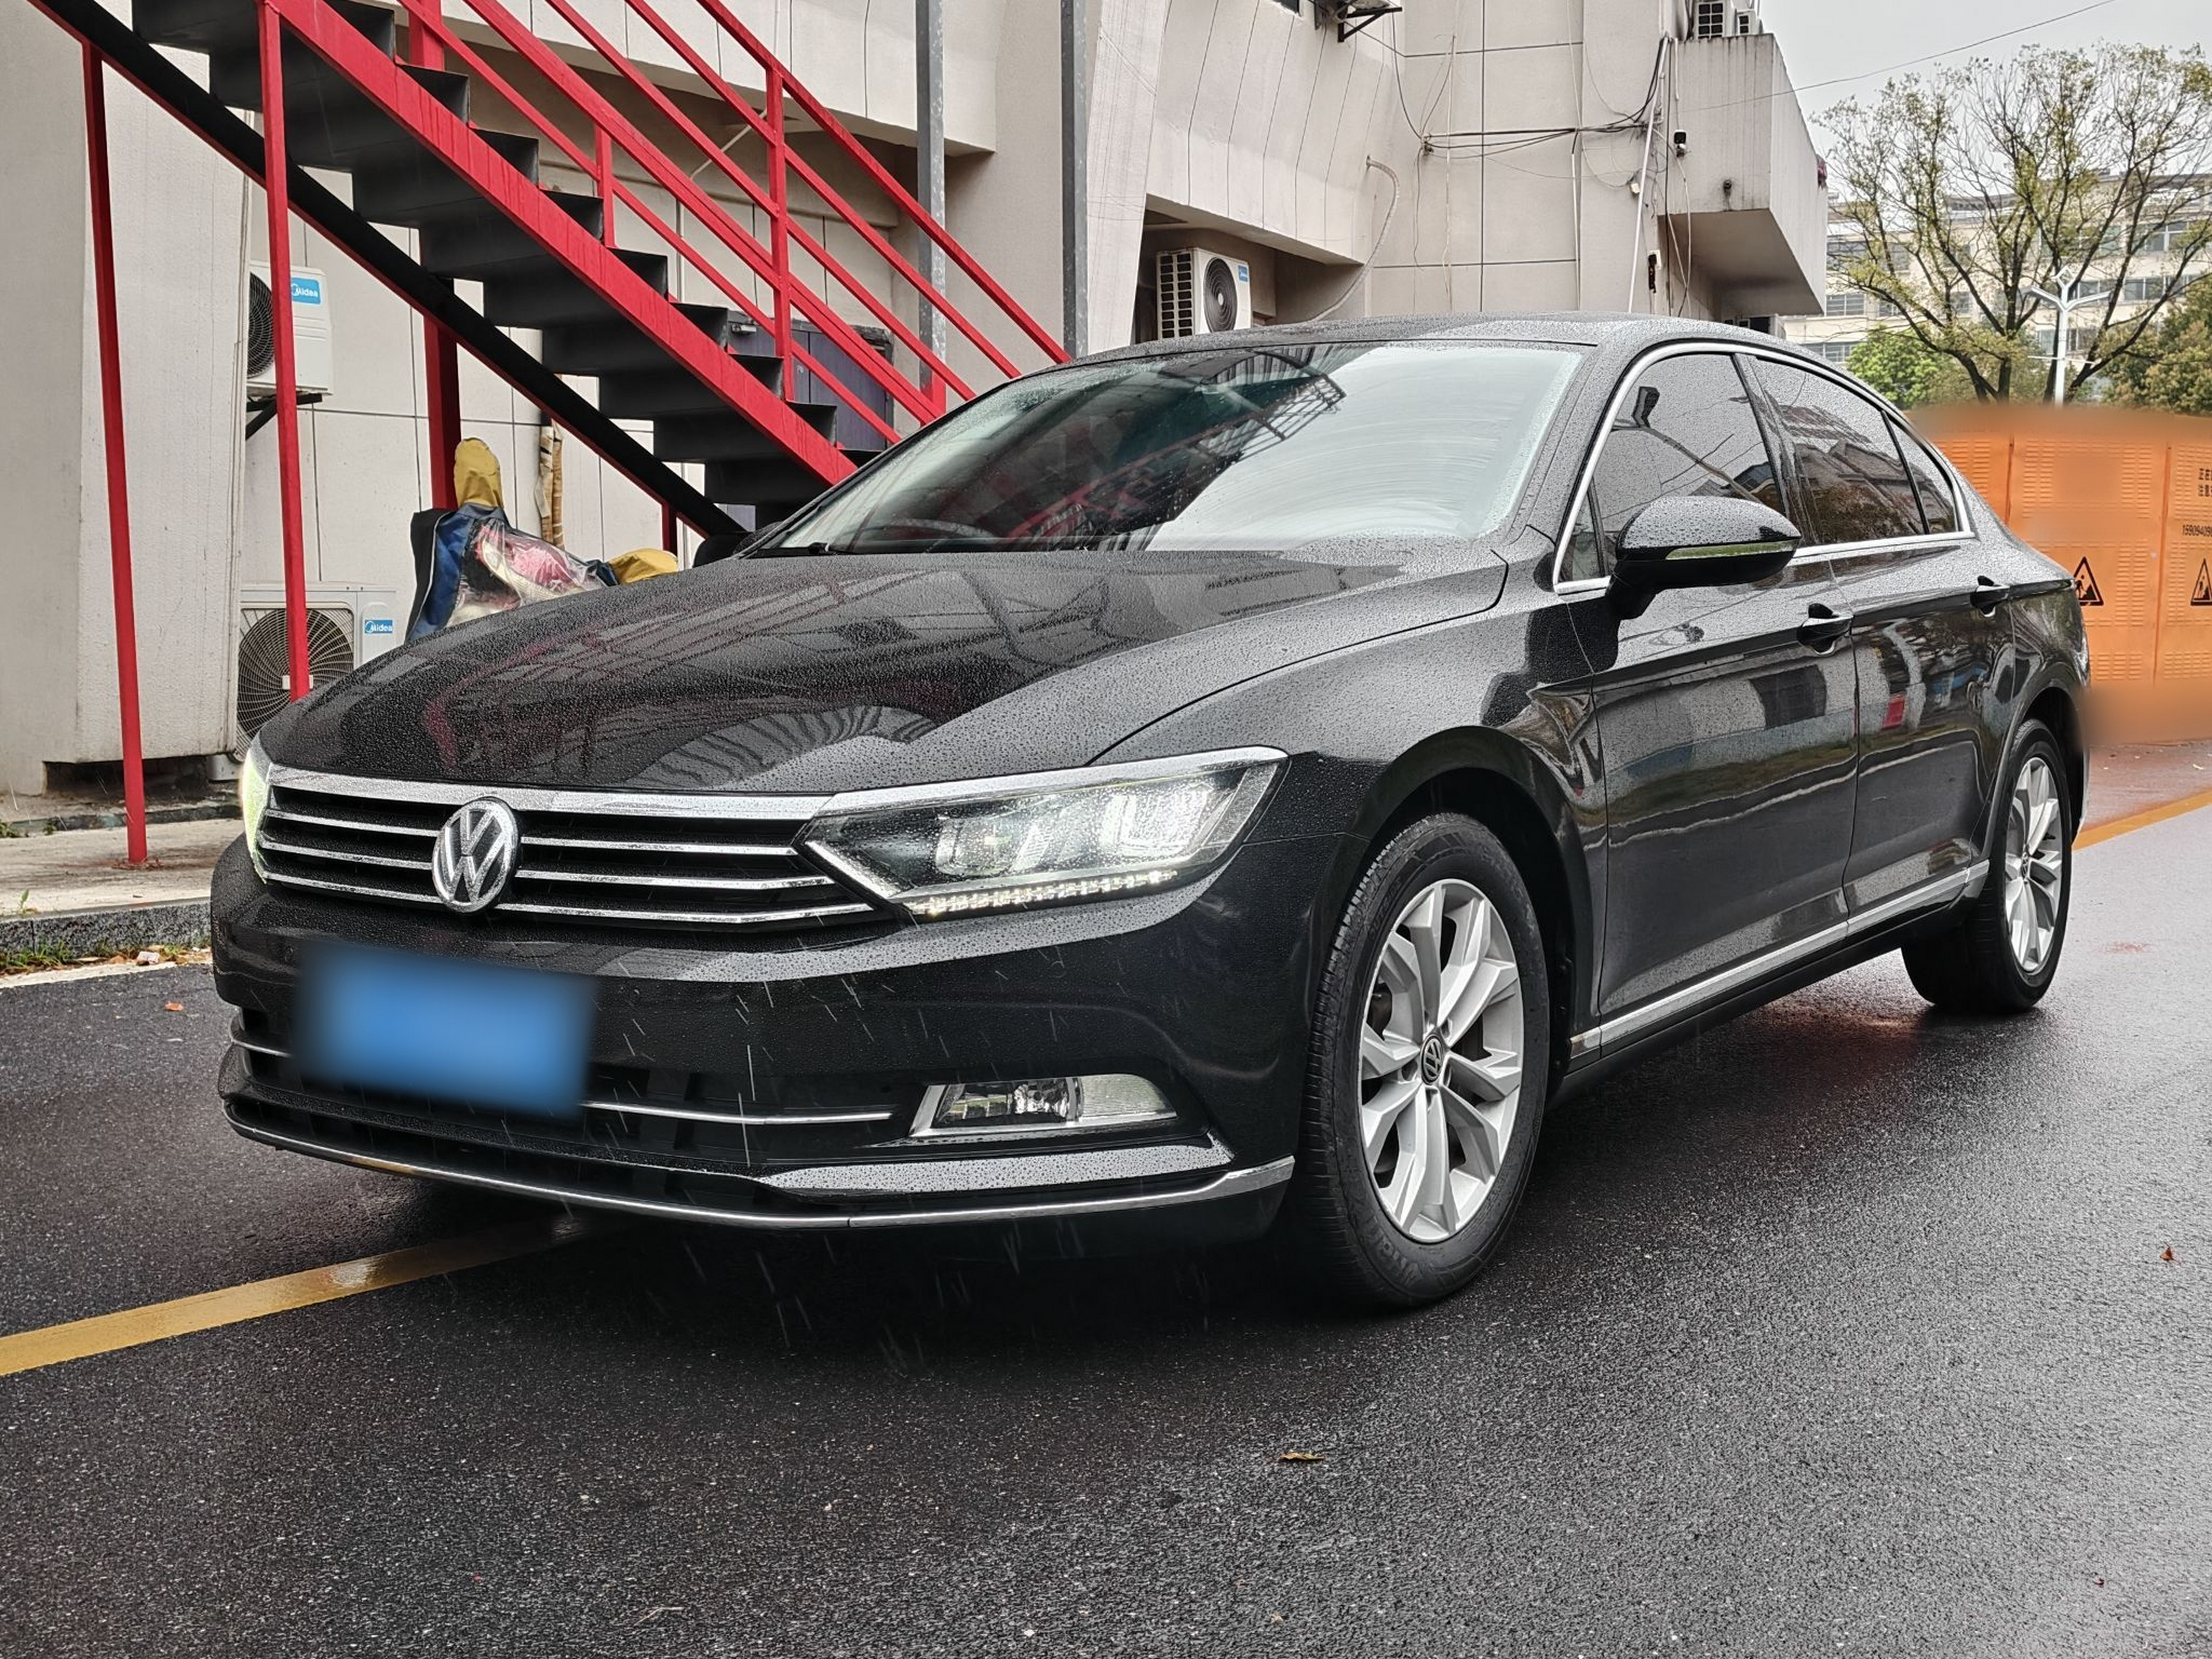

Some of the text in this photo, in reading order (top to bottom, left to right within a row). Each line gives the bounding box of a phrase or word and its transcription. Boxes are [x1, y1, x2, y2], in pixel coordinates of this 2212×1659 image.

[293, 285, 318, 298] Midea
[367, 622, 393, 632] Midea
[433, 800, 514, 912] VW
[1423, 1038, 1442, 1080] VW
